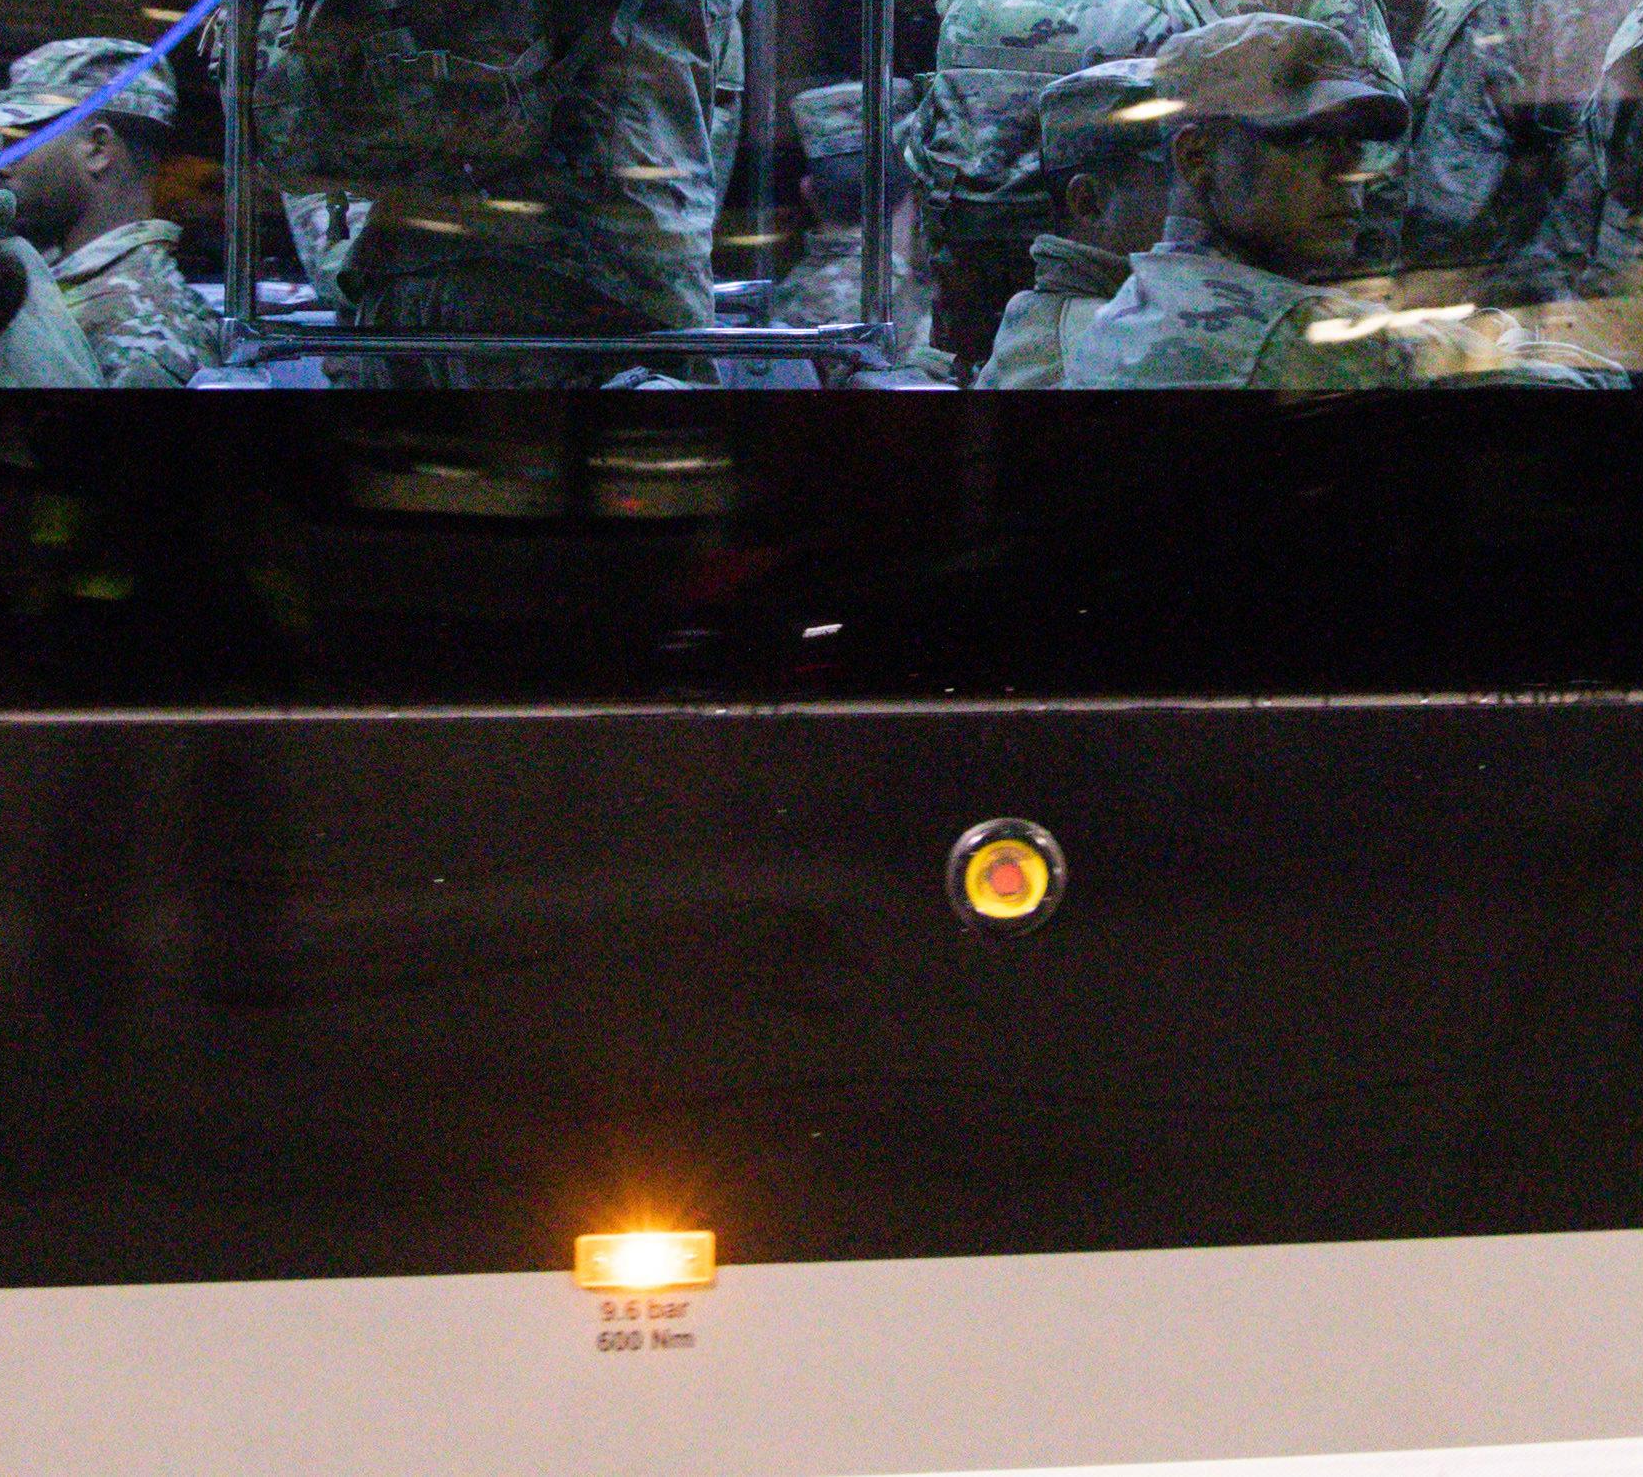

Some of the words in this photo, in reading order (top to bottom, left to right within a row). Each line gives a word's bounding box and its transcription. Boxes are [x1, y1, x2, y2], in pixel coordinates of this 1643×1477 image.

[647, 1299, 690, 1319] bar
[597, 1330, 643, 1352] 600
[651, 1328, 695, 1350] Nm
